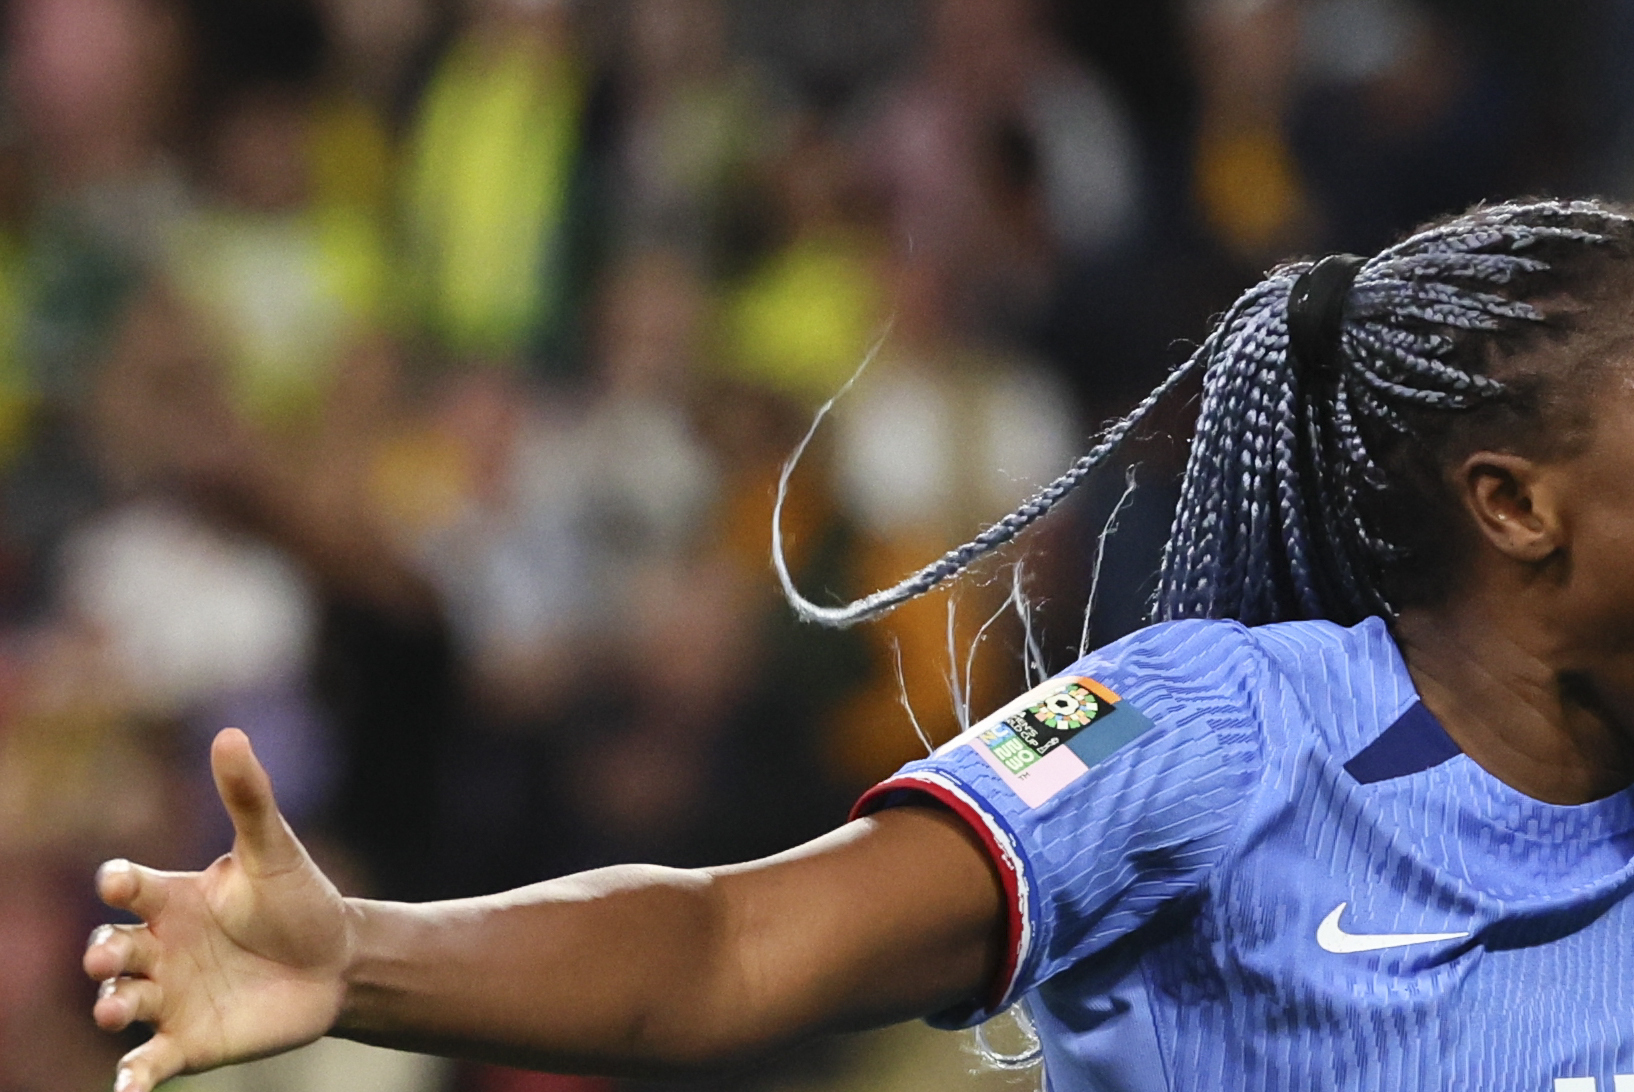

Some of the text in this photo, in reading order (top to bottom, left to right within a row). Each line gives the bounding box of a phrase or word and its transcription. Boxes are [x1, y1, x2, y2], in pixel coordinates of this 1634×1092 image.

[1002, 738, 1035, 763] 20
[1020, 731, 1039, 746] CUP
[993, 747, 1024, 771] 23
